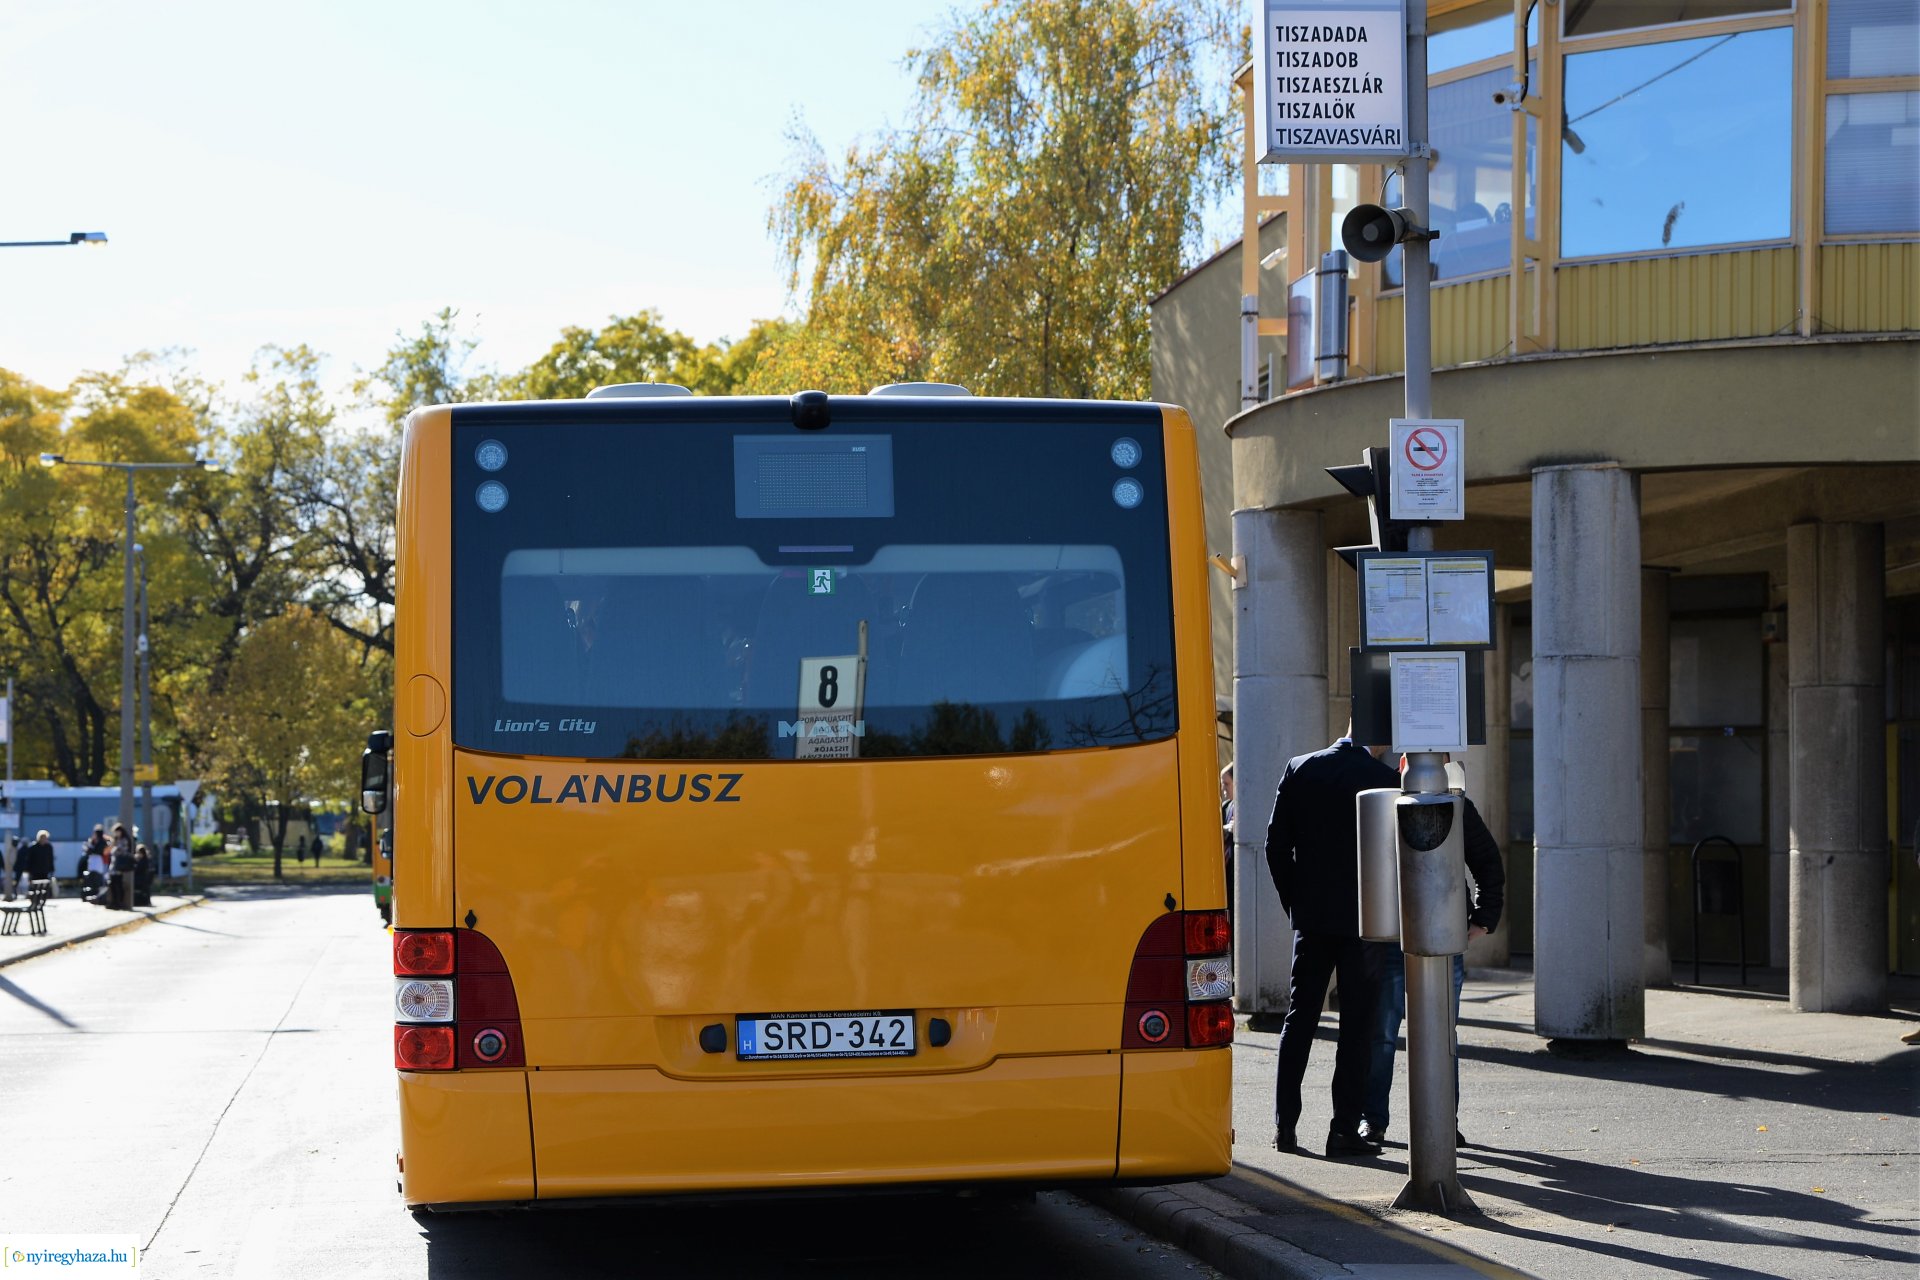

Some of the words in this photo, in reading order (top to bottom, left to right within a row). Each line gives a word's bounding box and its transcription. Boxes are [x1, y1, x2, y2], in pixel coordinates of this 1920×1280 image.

[1276, 26, 1368, 43] TISZADADA
[1277, 51, 1358, 68] TISZADOB
[1277, 72, 1383, 94] TISZAESZLÁR
[1277, 98, 1355, 119] TISZALÖK
[1276, 125, 1401, 145] TISZAVASVÁRI
[494, 719, 550, 732] Lion's
[558, 718, 596, 734] City
[778, 720, 865, 737] MAN
[467, 773, 744, 804] VOLÁNBUSZ
[743, 1040, 752, 1051] H
[764, 1019, 906, 1050] SRD-342
